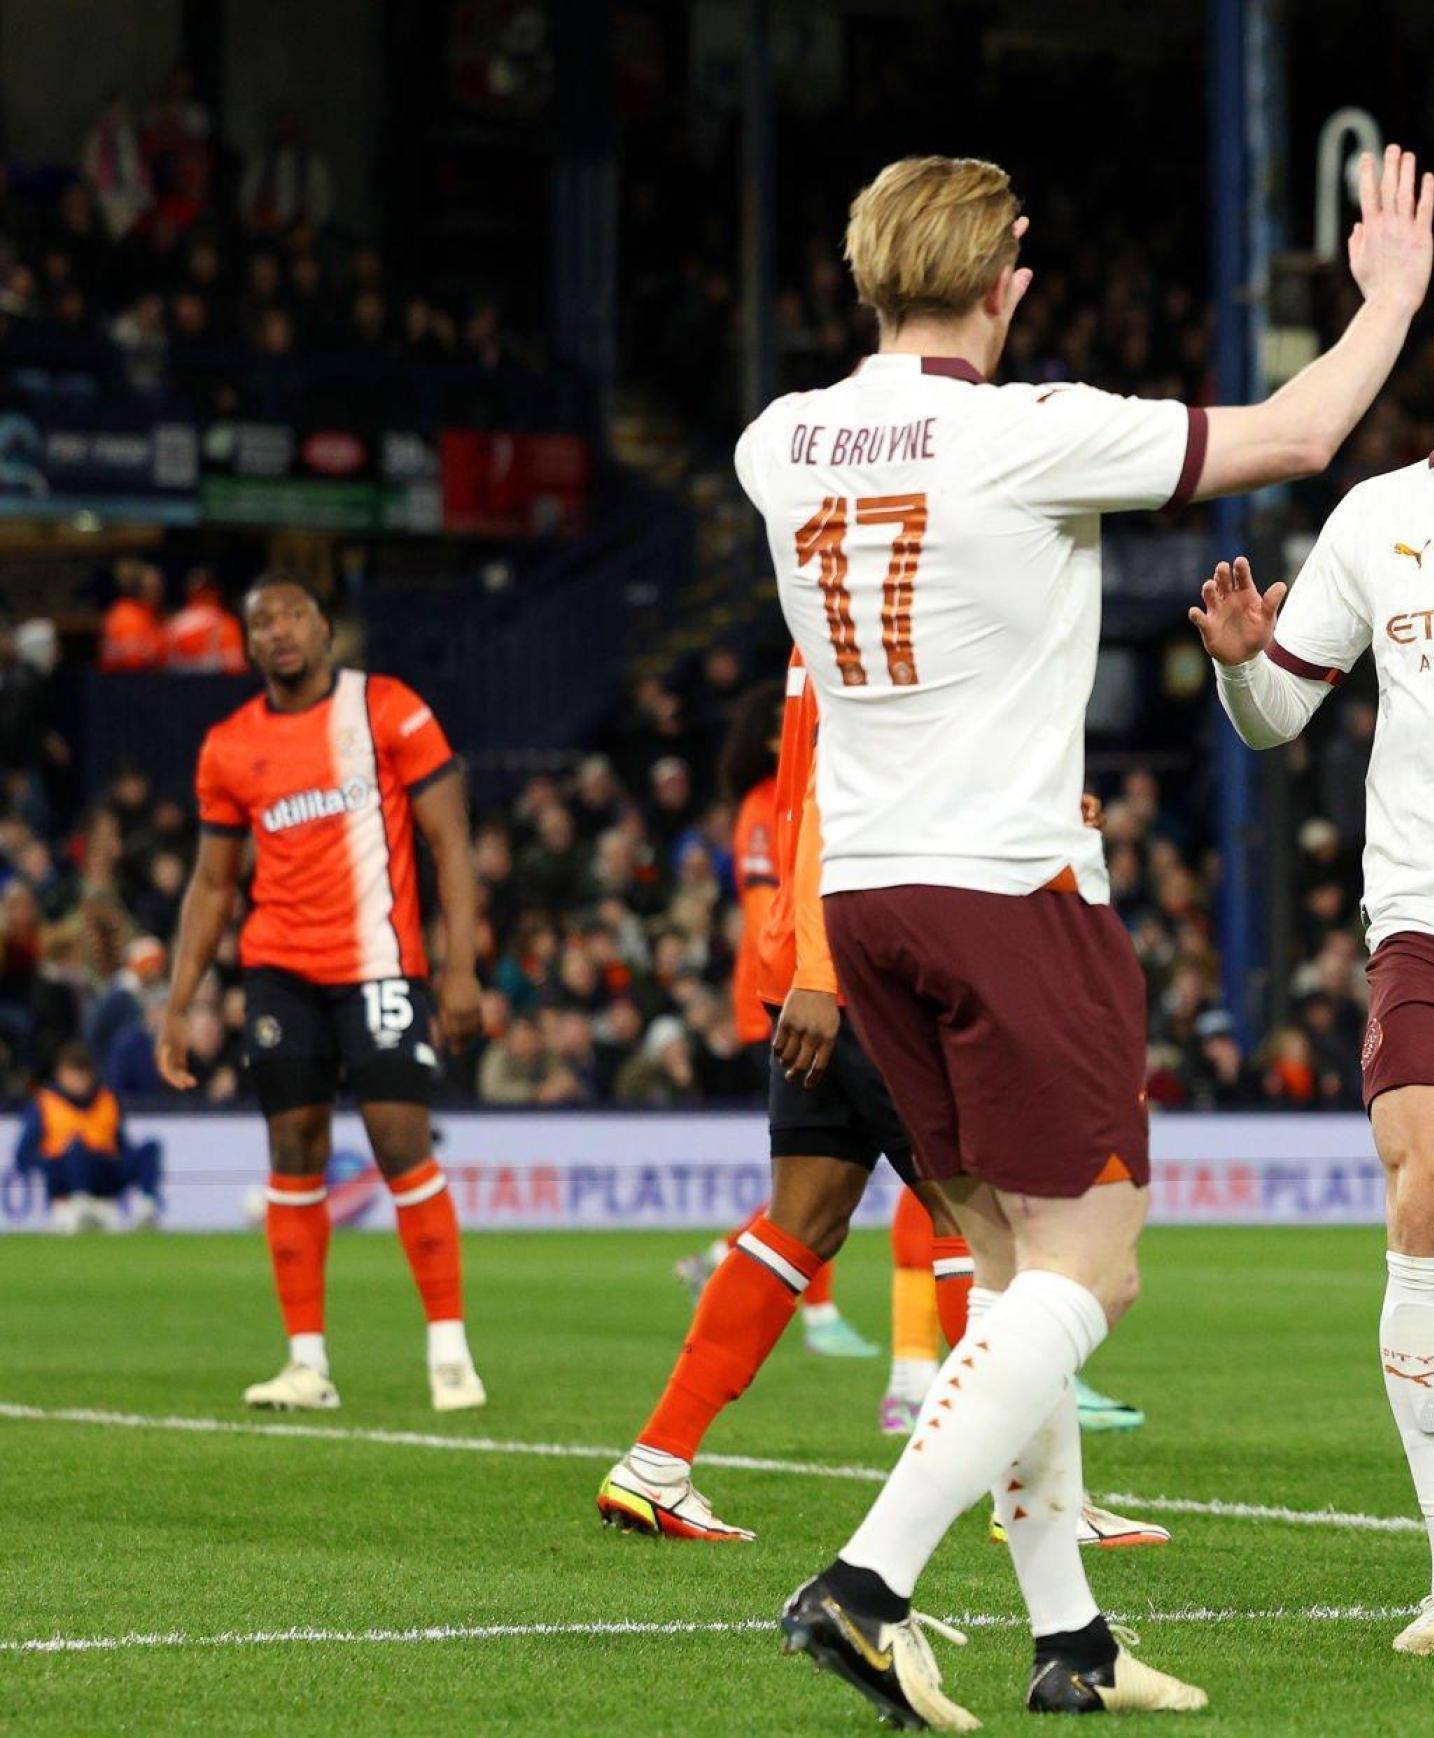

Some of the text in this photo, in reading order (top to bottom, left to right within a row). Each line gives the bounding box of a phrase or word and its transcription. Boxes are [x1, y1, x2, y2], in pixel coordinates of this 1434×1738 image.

[790, 417, 936, 466] DE BRUYNE
[794, 492, 927, 686] 17
[360, 979, 414, 1034] 15
